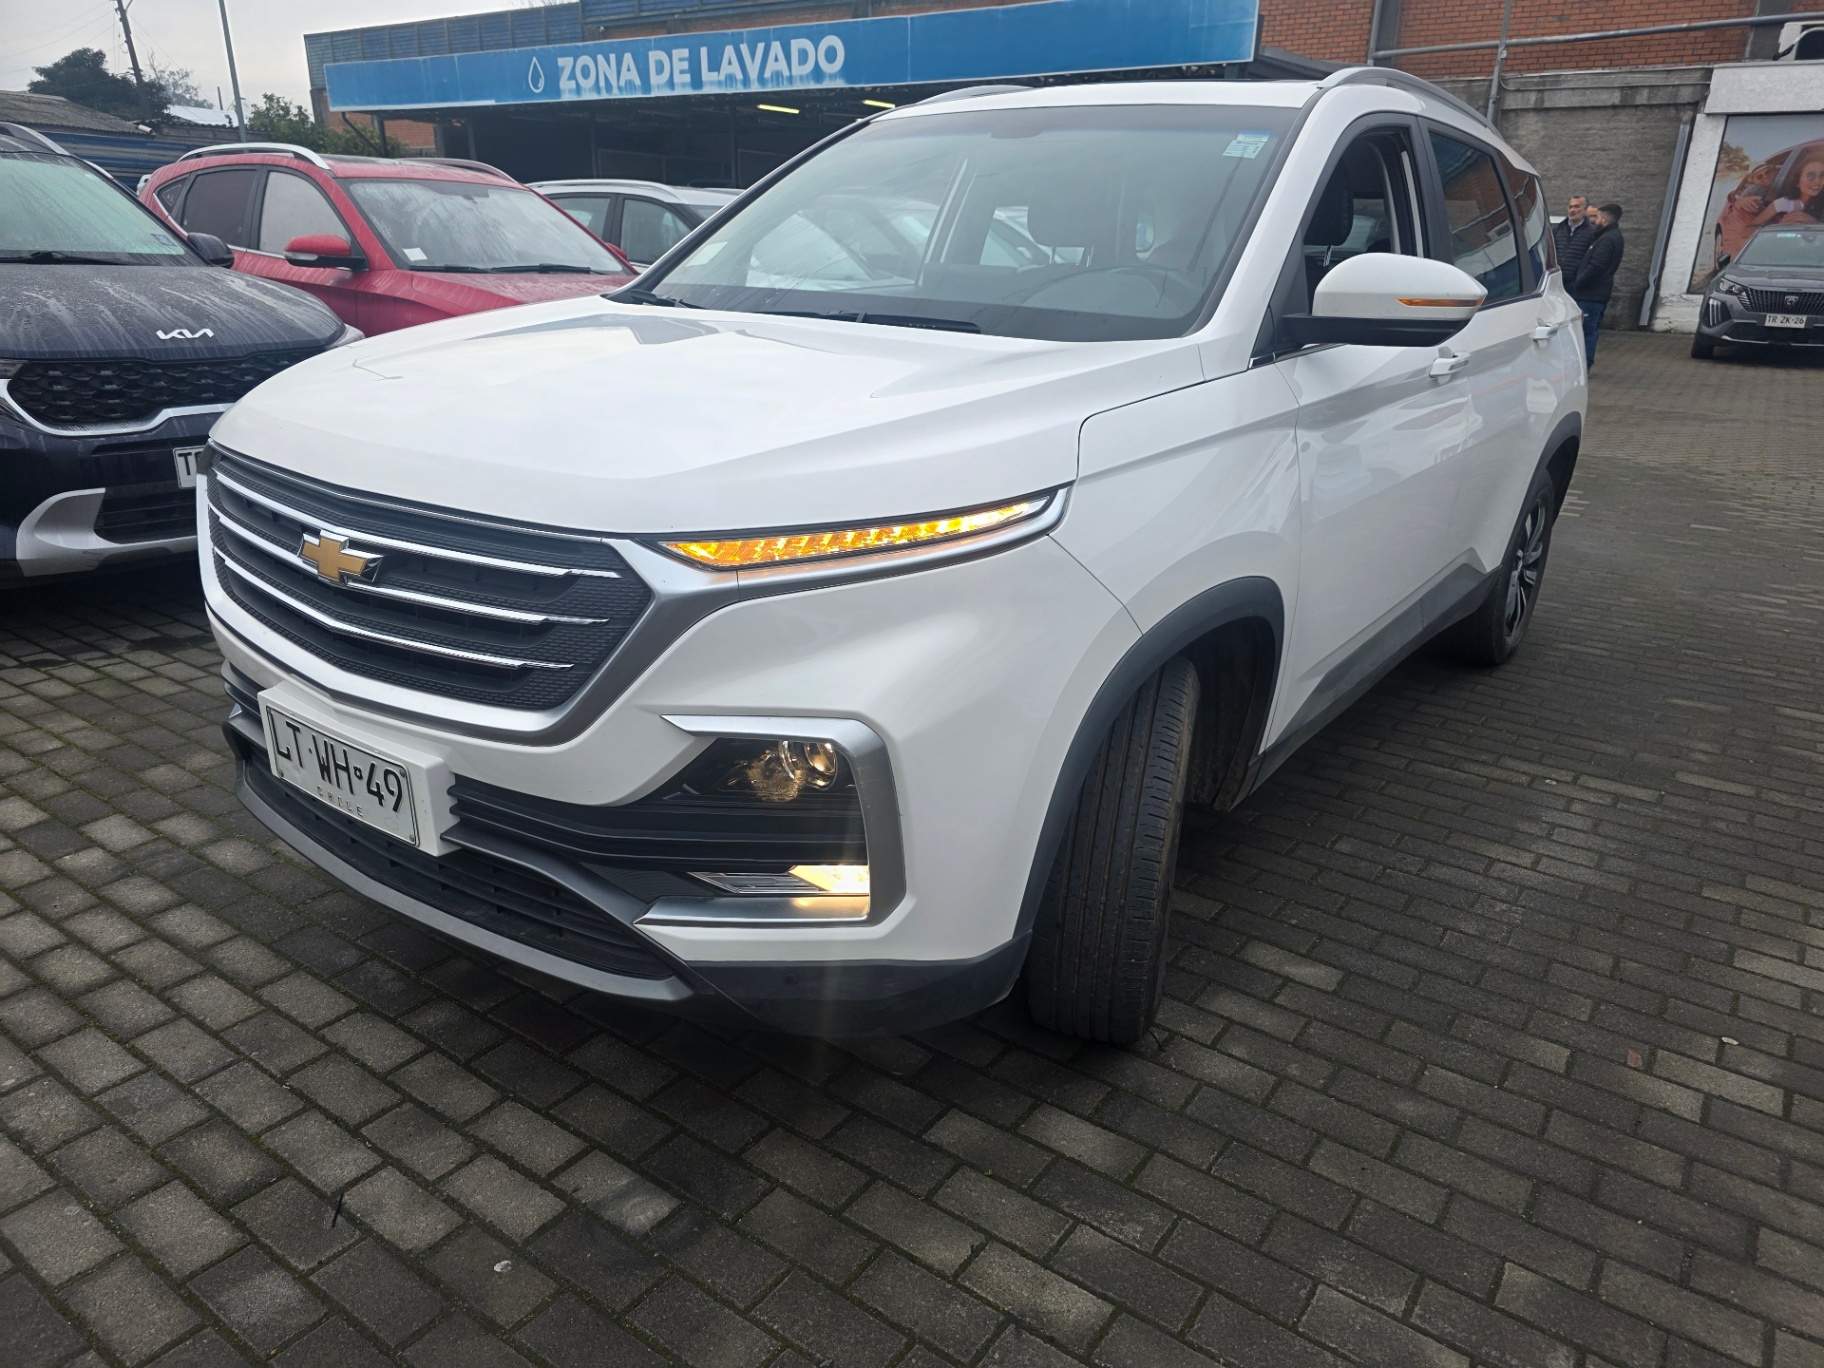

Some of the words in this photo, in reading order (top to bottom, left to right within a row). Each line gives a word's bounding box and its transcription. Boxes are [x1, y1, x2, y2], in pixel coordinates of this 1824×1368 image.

[557, 52, 641, 90] ZONA
[649, 48, 692, 84] DE
[700, 35, 846, 82] LAVADO
[156, 328, 215, 340] KIA
